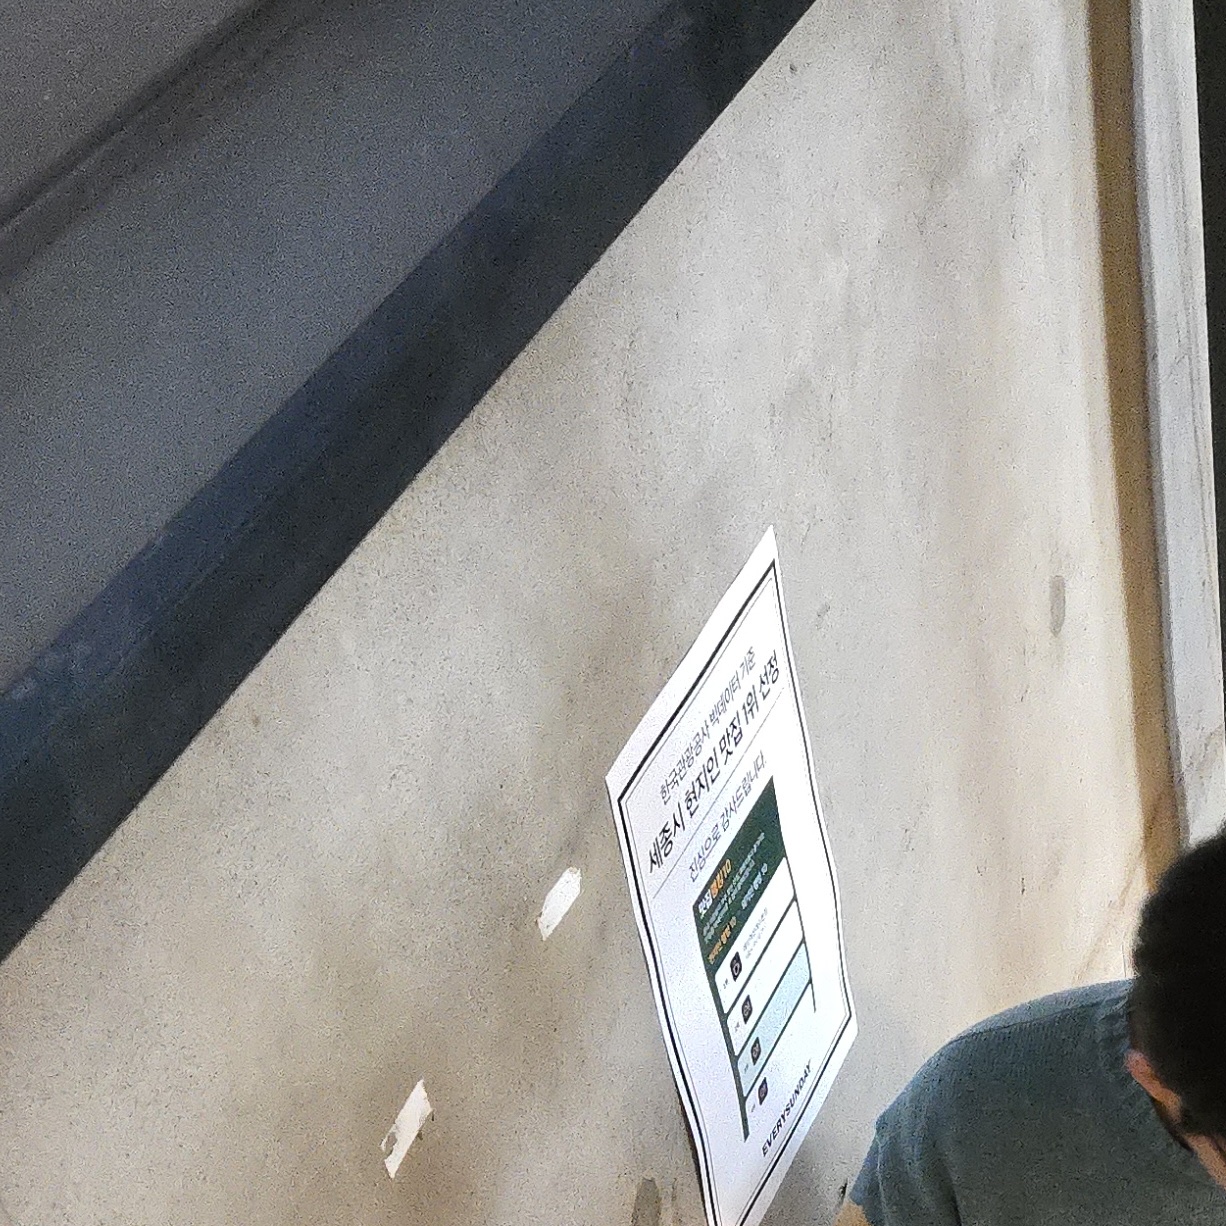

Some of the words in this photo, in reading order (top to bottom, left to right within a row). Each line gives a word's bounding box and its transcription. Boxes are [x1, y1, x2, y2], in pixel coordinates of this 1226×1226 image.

[649, 802, 686, 872] 세종시
[684, 747, 721, 819] 현지인
[718, 712, 743, 766] 맛집
[741, 684, 759, 725] 1위
[758, 649, 780, 701] 선정
[660, 720, 710, 805] 한국관광공사
[708, 670, 742, 726] 빅데이터
[739, 646, 756, 679] 기준
[688, 822, 722, 883] 진심으로
[719, 751, 767, 833] 감사드립니다.
[761, 1059, 812, 1157] EVERYSUNDAY
